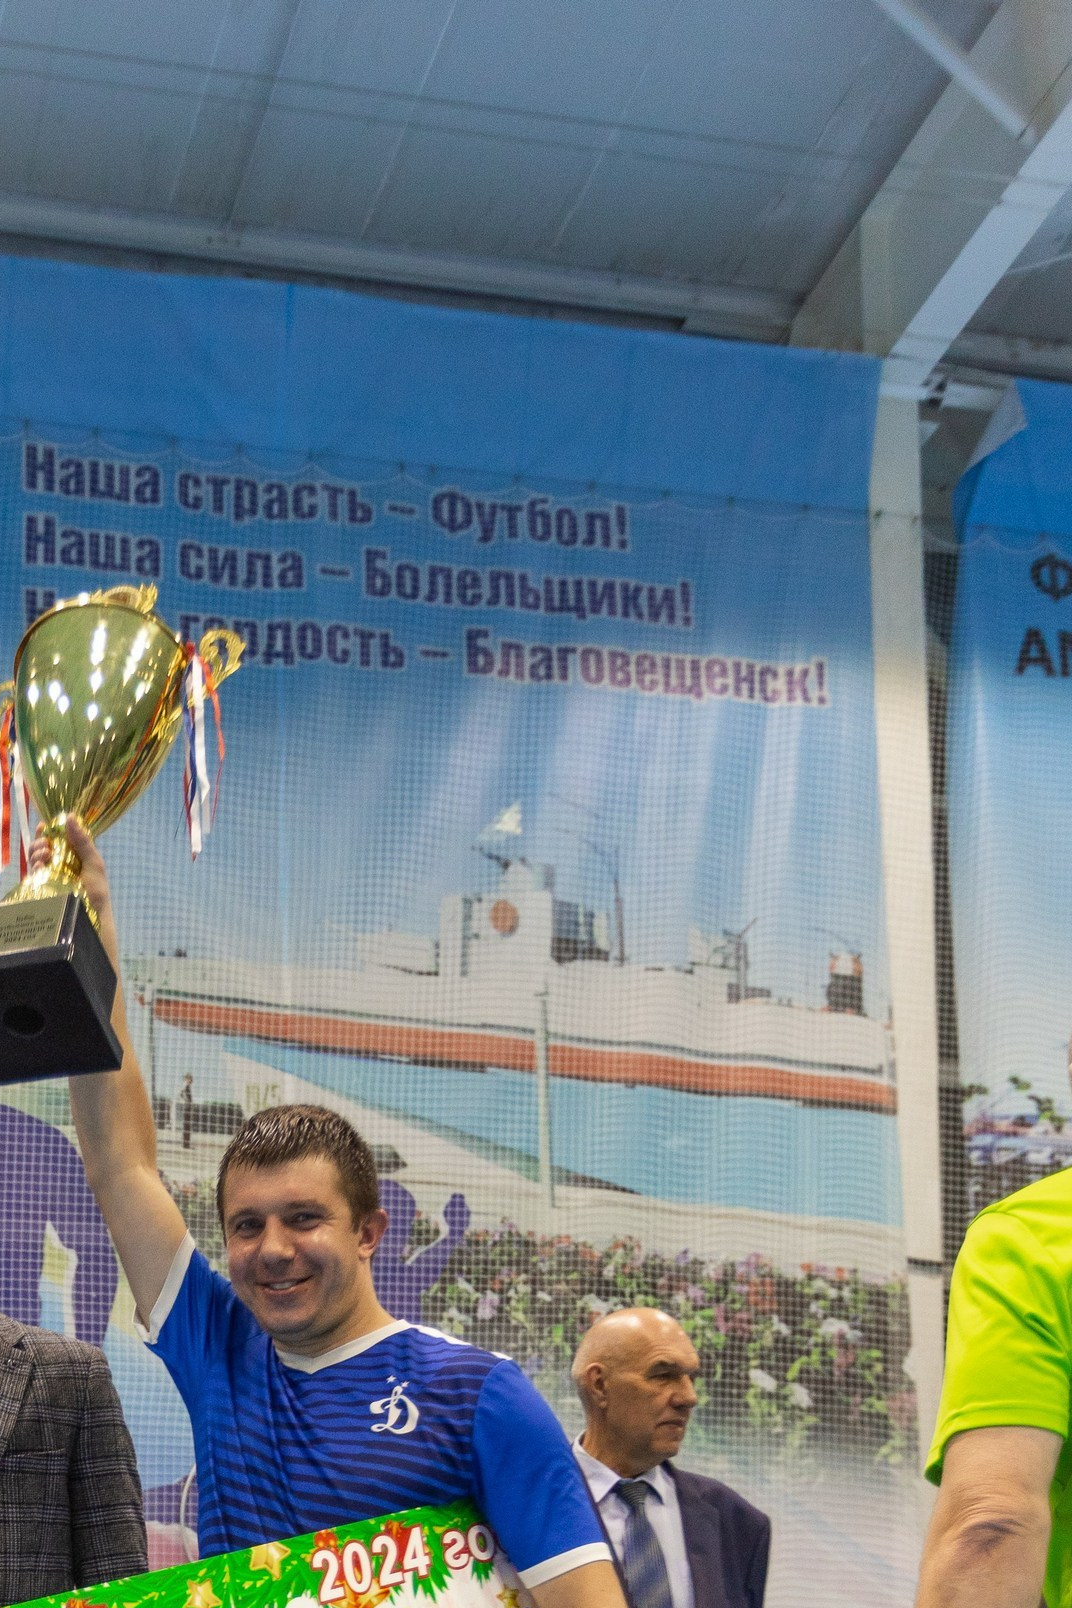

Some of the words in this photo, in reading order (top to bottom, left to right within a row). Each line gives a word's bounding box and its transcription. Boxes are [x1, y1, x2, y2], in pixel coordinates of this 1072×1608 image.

[24, 442, 162, 506] Наша
[178, 471, 374, 527] страсть
[431, 487, 628, 550] Футбол!
[24, 514, 162, 578] Наша
[178, 541, 305, 592] сила
[364, 547, 694, 628] Болельщики!
[464, 627, 828, 707] Благовещенск!
[311, 1525, 431, 1605] 2024
